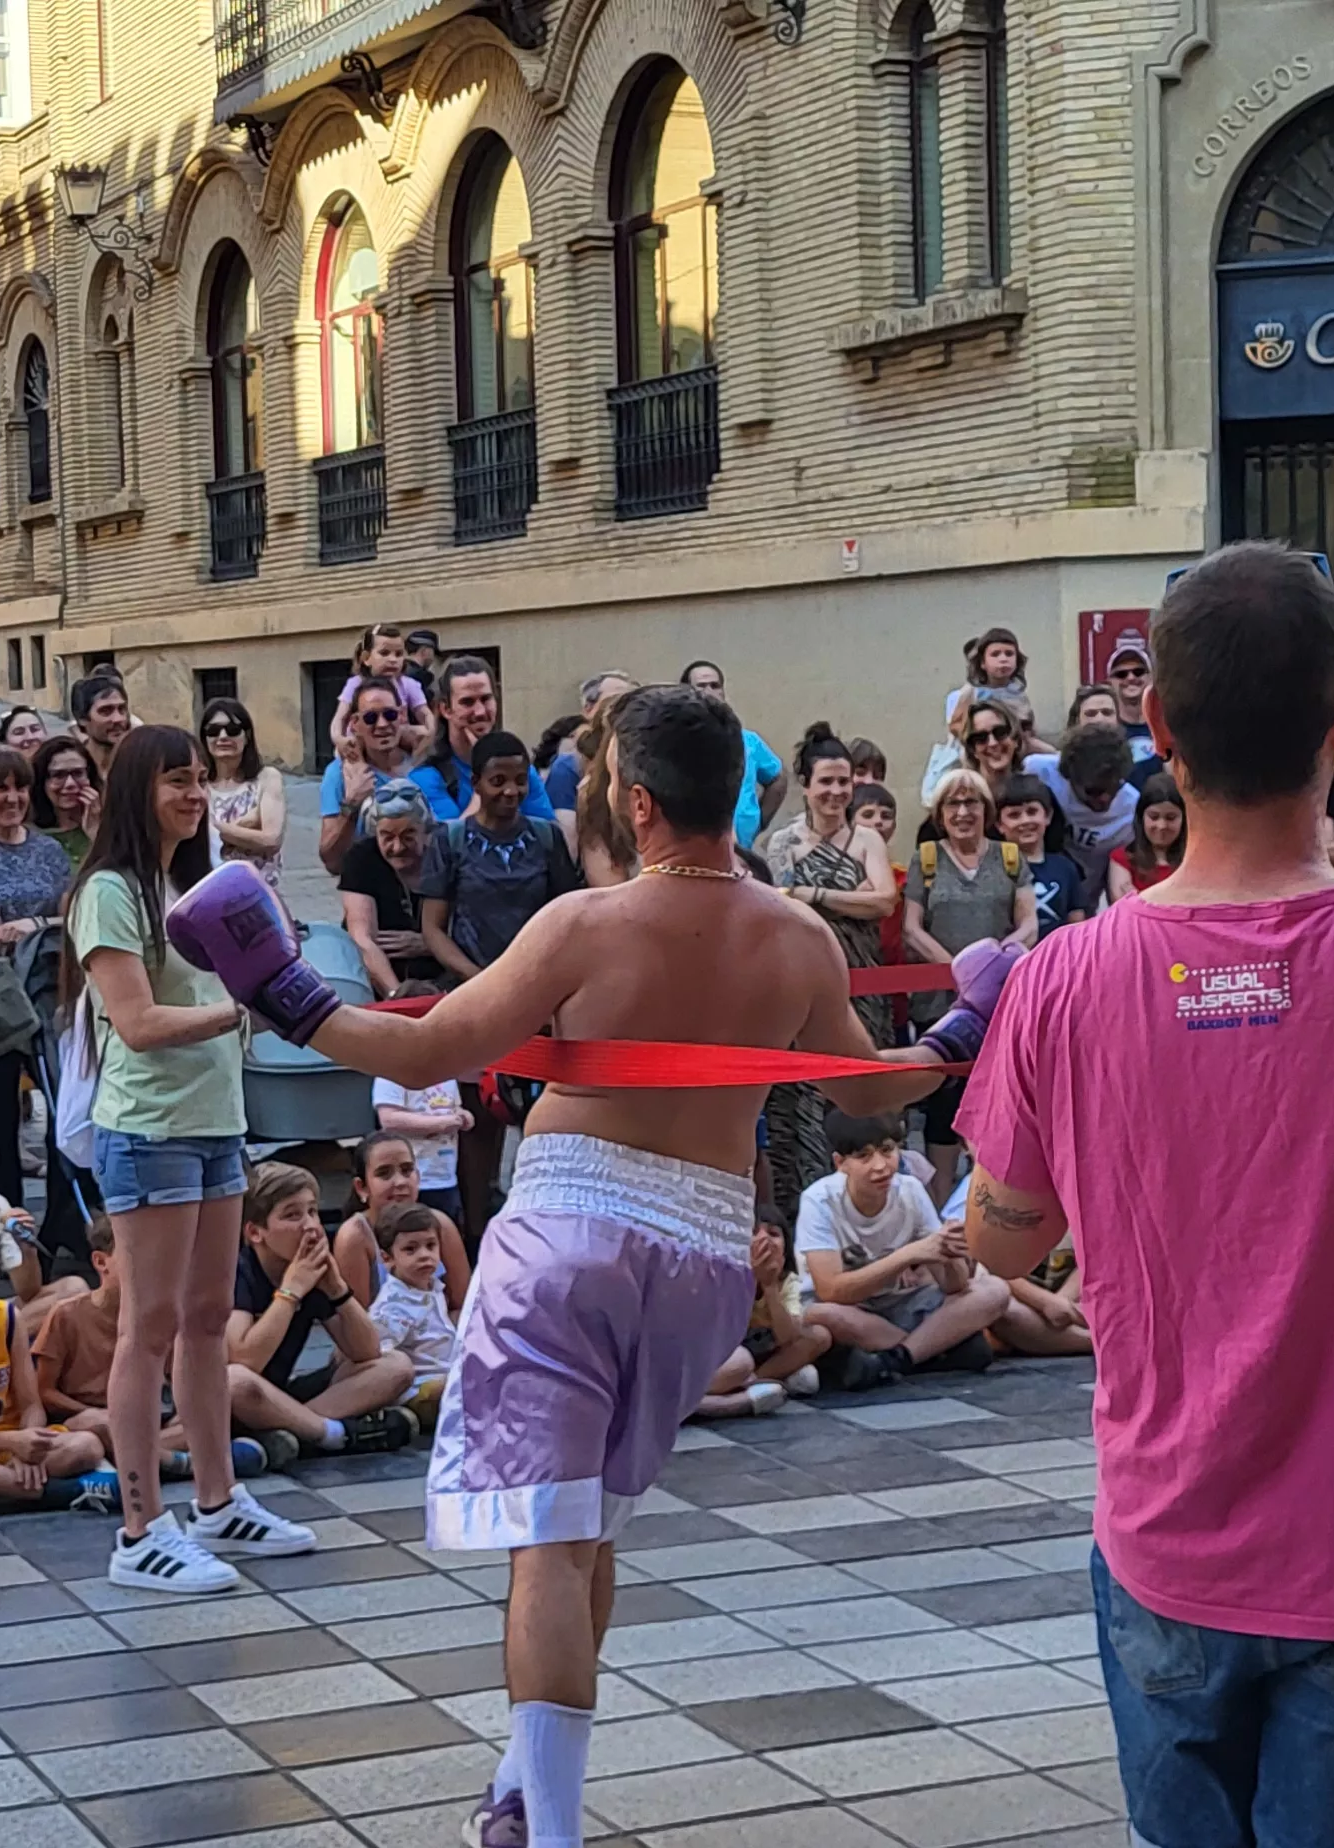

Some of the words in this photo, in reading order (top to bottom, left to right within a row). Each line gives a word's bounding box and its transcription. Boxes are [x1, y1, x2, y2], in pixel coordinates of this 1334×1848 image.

[1193, 54, 1314, 179] CORREOS
[1201, 971, 1265, 992] USUAL
[1177, 987, 1283, 1011] SUSPECTS
